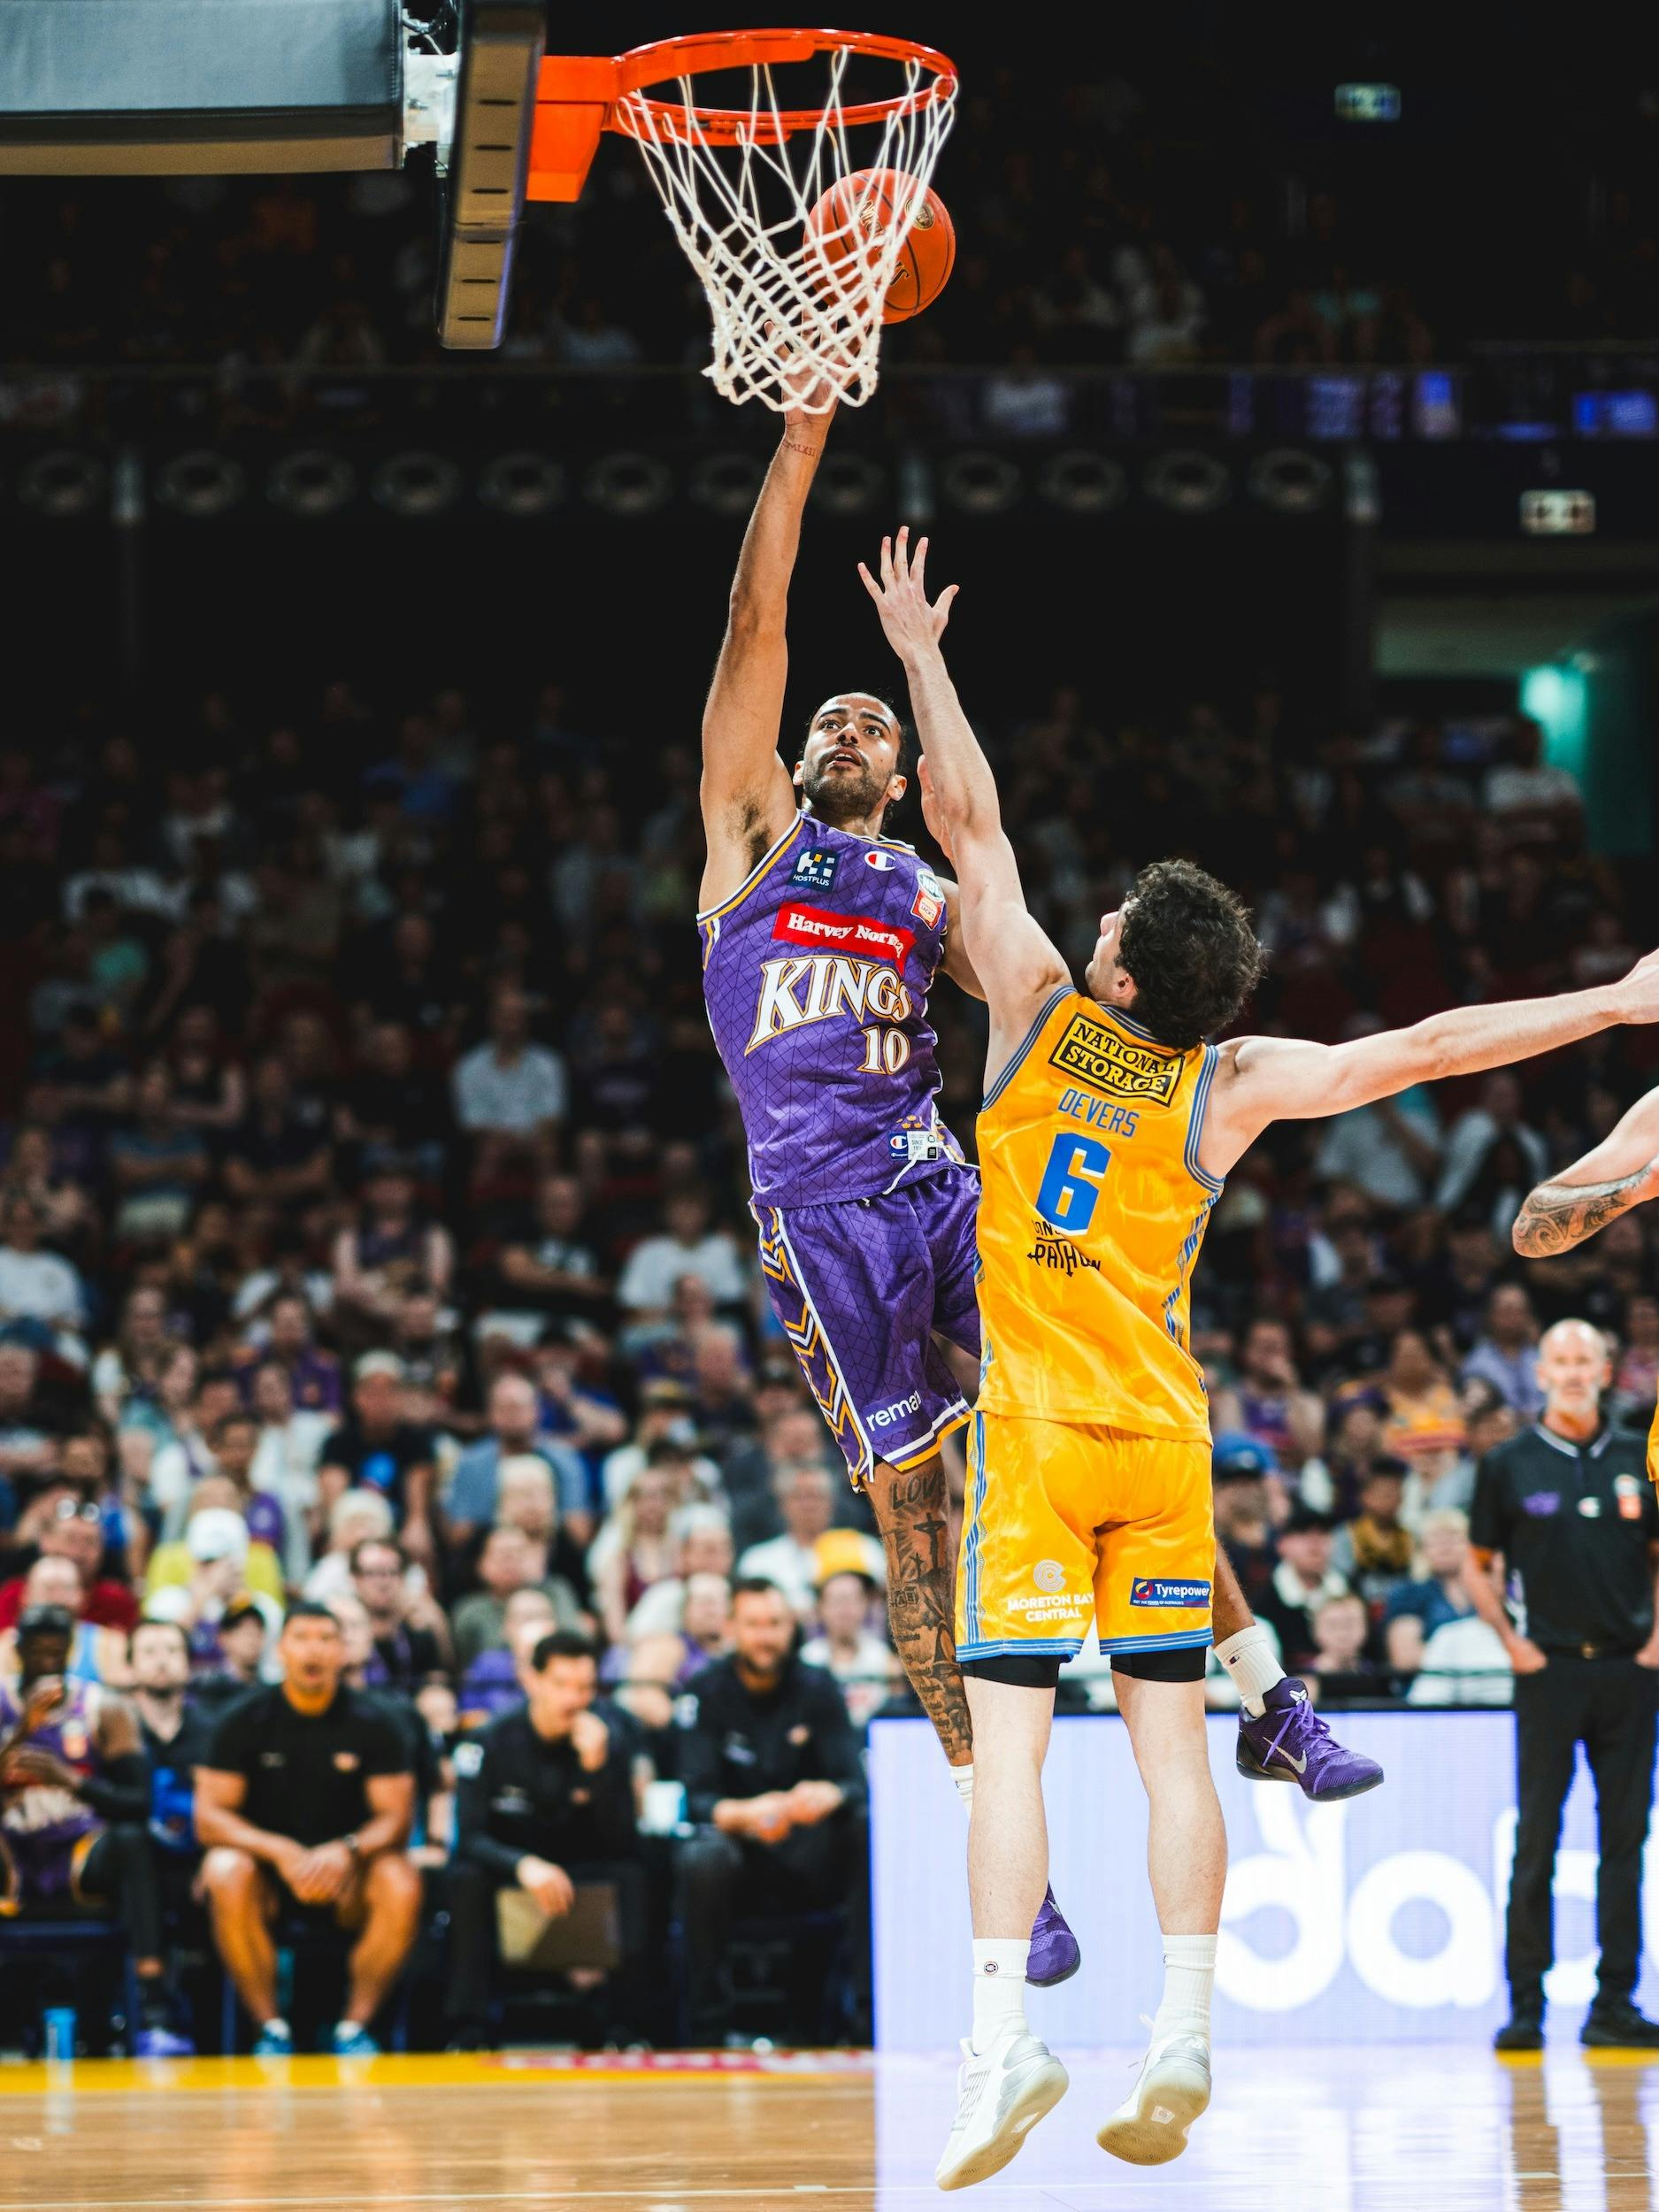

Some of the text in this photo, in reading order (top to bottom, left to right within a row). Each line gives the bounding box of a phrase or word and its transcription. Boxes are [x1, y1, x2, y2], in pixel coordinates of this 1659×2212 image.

[793, 874, 830, 887] HOSTPLUS
[787, 913, 853, 939] Harvey
[744, 955, 912, 1056] KINGS
[856, 1025, 910, 1075] 10
[1065, 1045, 1166, 1093] STORAGE
[1072, 1022, 1175, 1074] NATIONAL
[1057, 1088, 1140, 1138] DEVERS
[1034, 1133, 1112, 1236] 6
[1007, 1593, 1094, 1614] MORETON BAY
[1025, 1607, 1083, 1623] CENTRAL
[1155, 1584, 1210, 1598] Tyrepower
